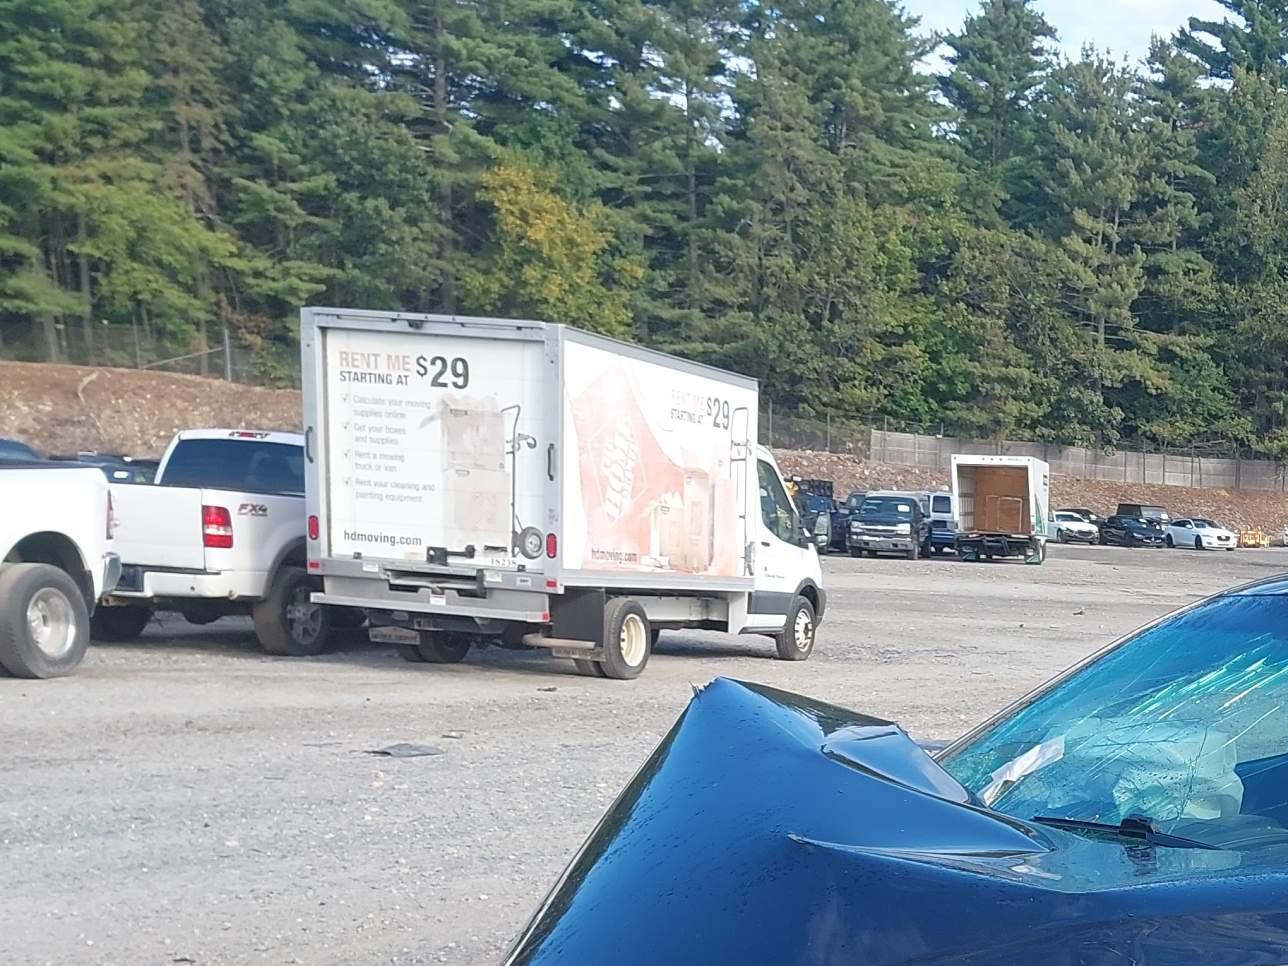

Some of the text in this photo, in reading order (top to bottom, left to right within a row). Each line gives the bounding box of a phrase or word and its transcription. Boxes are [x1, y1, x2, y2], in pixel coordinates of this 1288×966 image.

[339, 351, 411, 372] RENT ME
[339, 371, 409, 386] STARTING AT
[416, 354, 469, 389] $29
[405, 400, 431, 410] moving
[707, 396, 730, 430] $29
[421, 483, 435, 492] and
[385, 493, 423, 503] equipment
[239, 503, 268, 513] FX4
[344, 530, 422, 547] hdmoving.com
